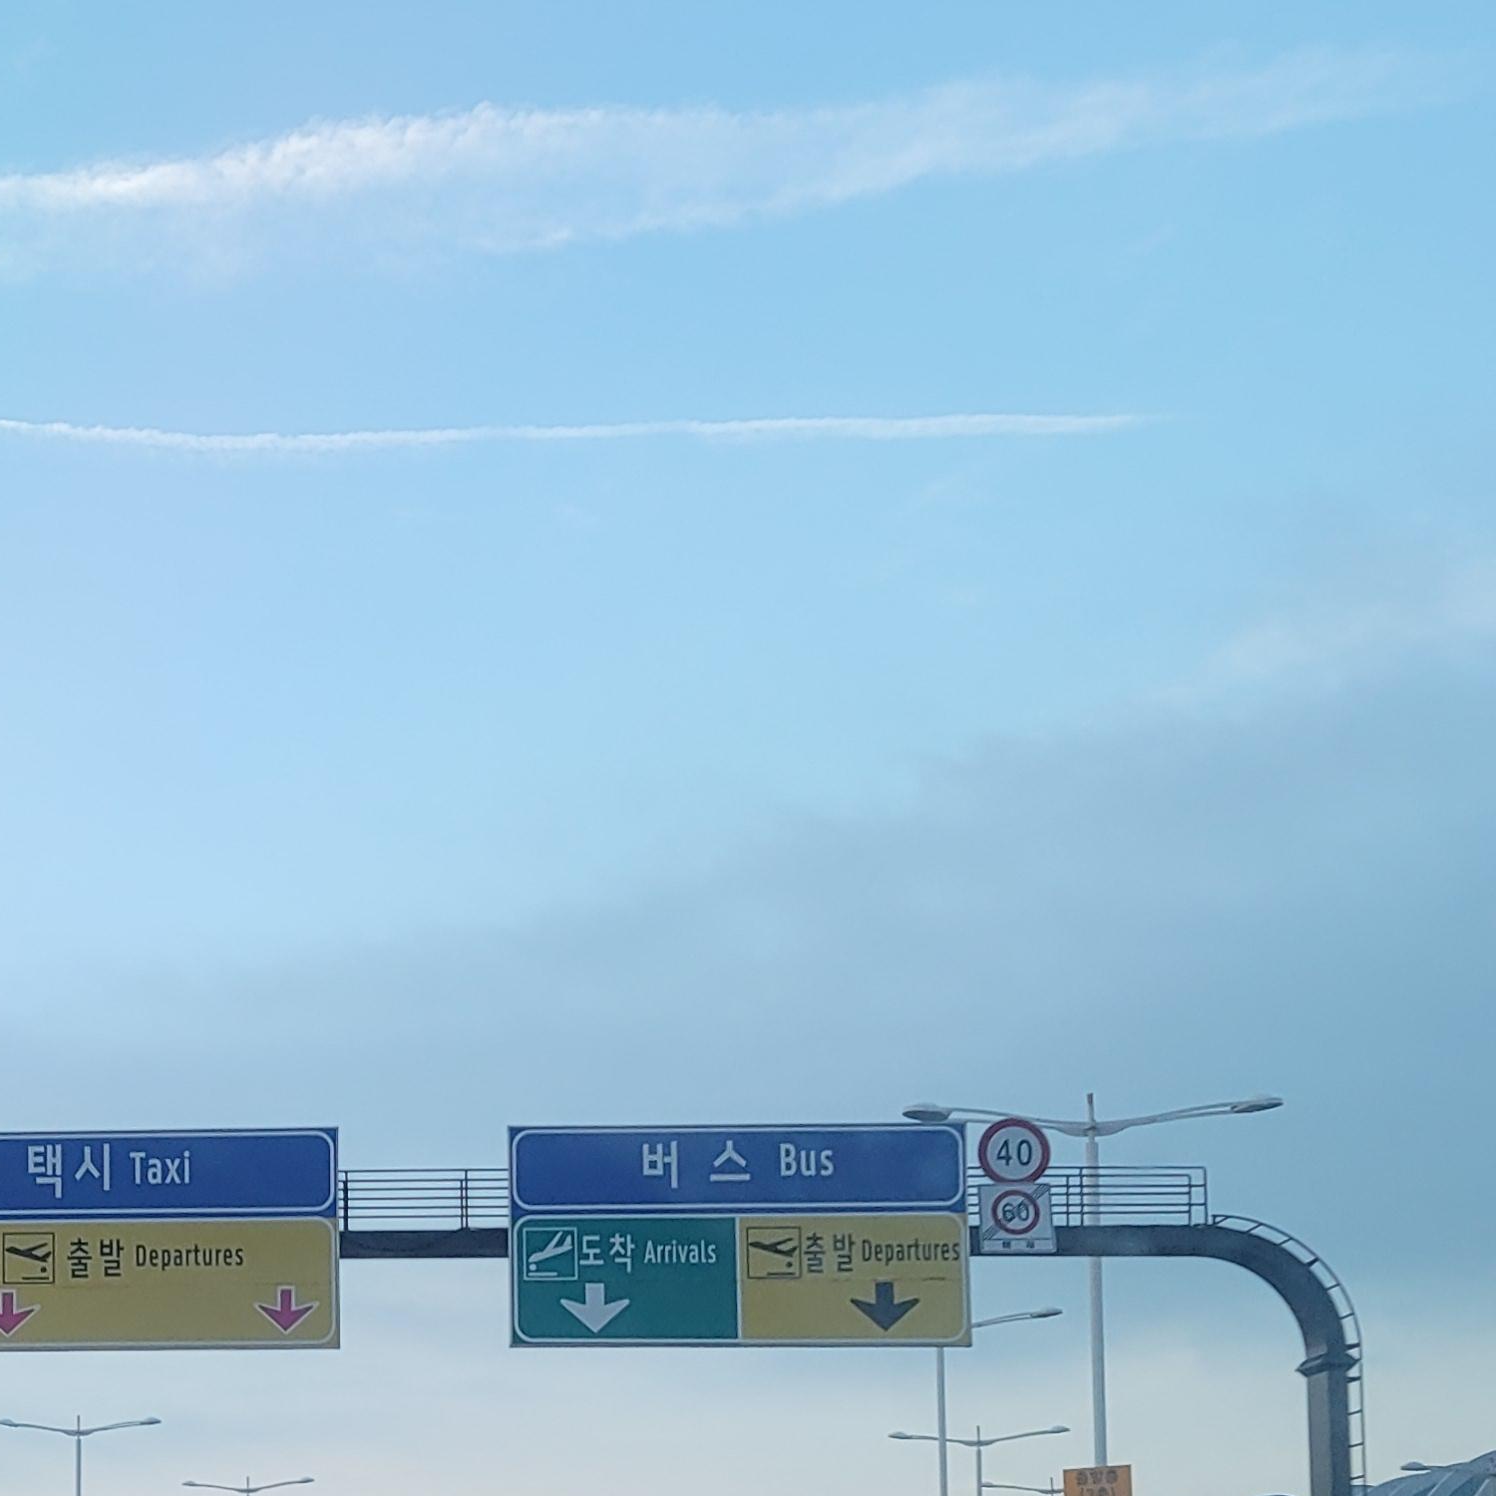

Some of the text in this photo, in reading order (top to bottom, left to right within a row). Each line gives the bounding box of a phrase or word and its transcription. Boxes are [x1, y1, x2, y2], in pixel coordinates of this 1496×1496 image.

[27, 1143, 111, 1199] 택시
[129, 1150, 191, 1186] Taxi
[641, 1139, 834, 1189] 버스 Bus
[996, 1139, 1033, 1167] 40
[67, 1237, 244, 1279] 출발 Departures
[579, 1233, 717, 1274] 도착 Arrivals
[804, 1231, 960, 1274] 출발 Departures
